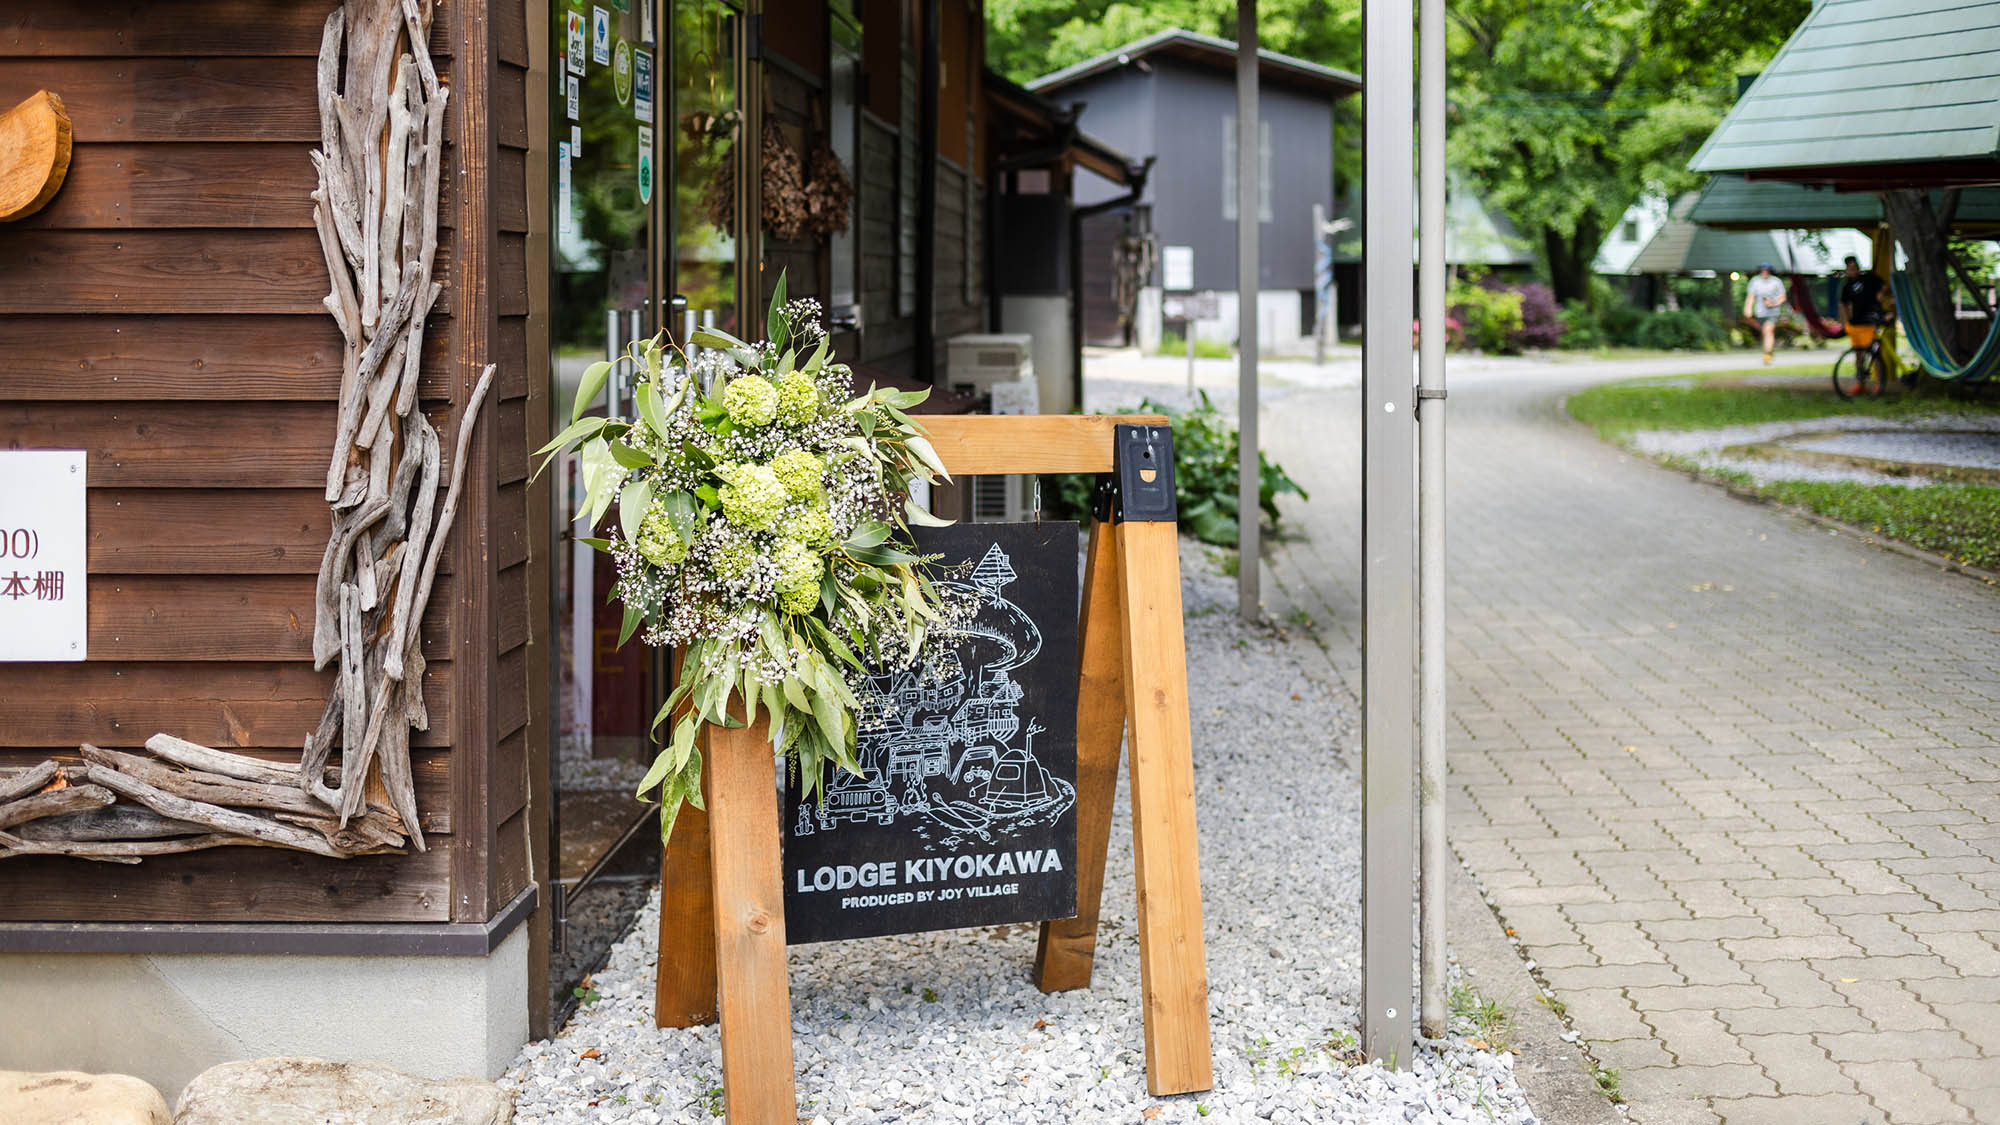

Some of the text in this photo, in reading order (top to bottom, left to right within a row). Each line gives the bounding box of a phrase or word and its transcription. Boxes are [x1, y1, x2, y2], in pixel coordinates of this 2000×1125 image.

[0, 570, 65, 601] 本棚
[797, 849, 1063, 893] LODGE KIYOKAWA
[841, 883, 1019, 909] PRODUCED BY JOY VILLAGE
